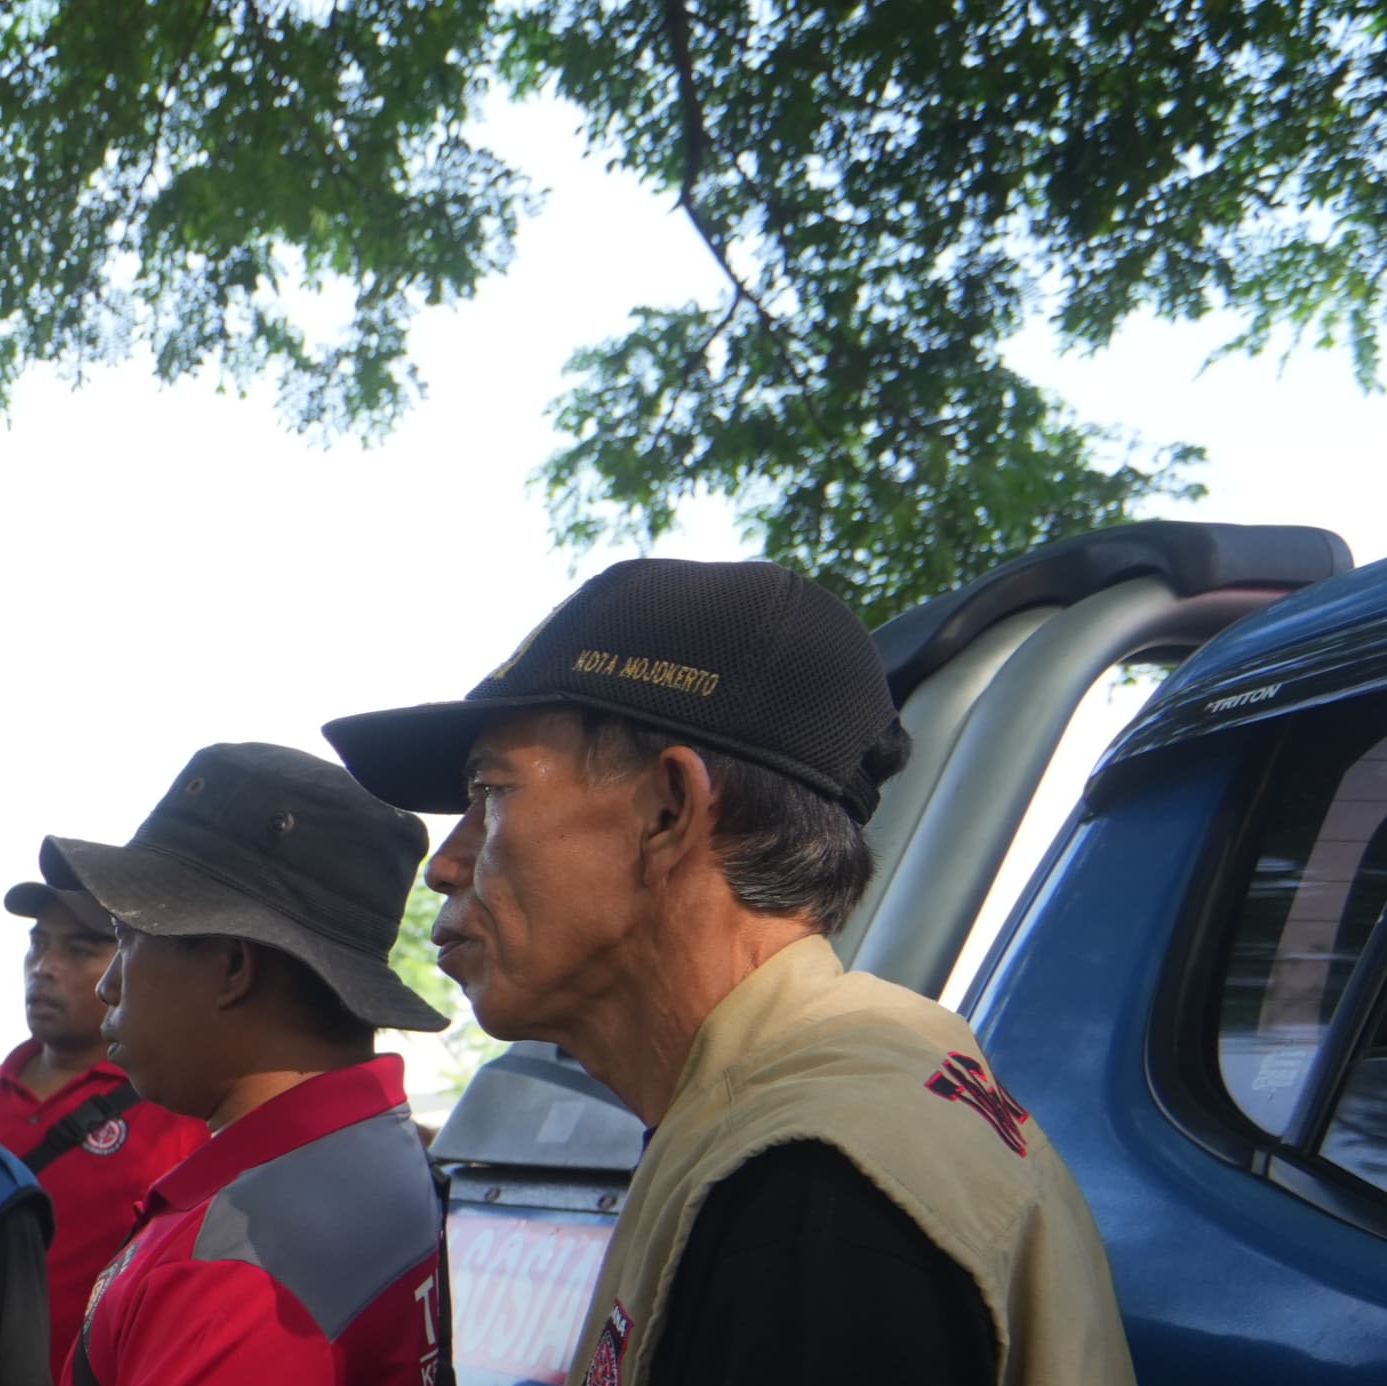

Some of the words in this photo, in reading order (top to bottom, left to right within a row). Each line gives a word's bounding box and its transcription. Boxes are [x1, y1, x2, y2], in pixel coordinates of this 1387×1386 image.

[572, 650, 618, 676] KOTA
[619, 656, 720, 697] MOJOKERTO
[1210, 683, 1283, 714] TRITON
